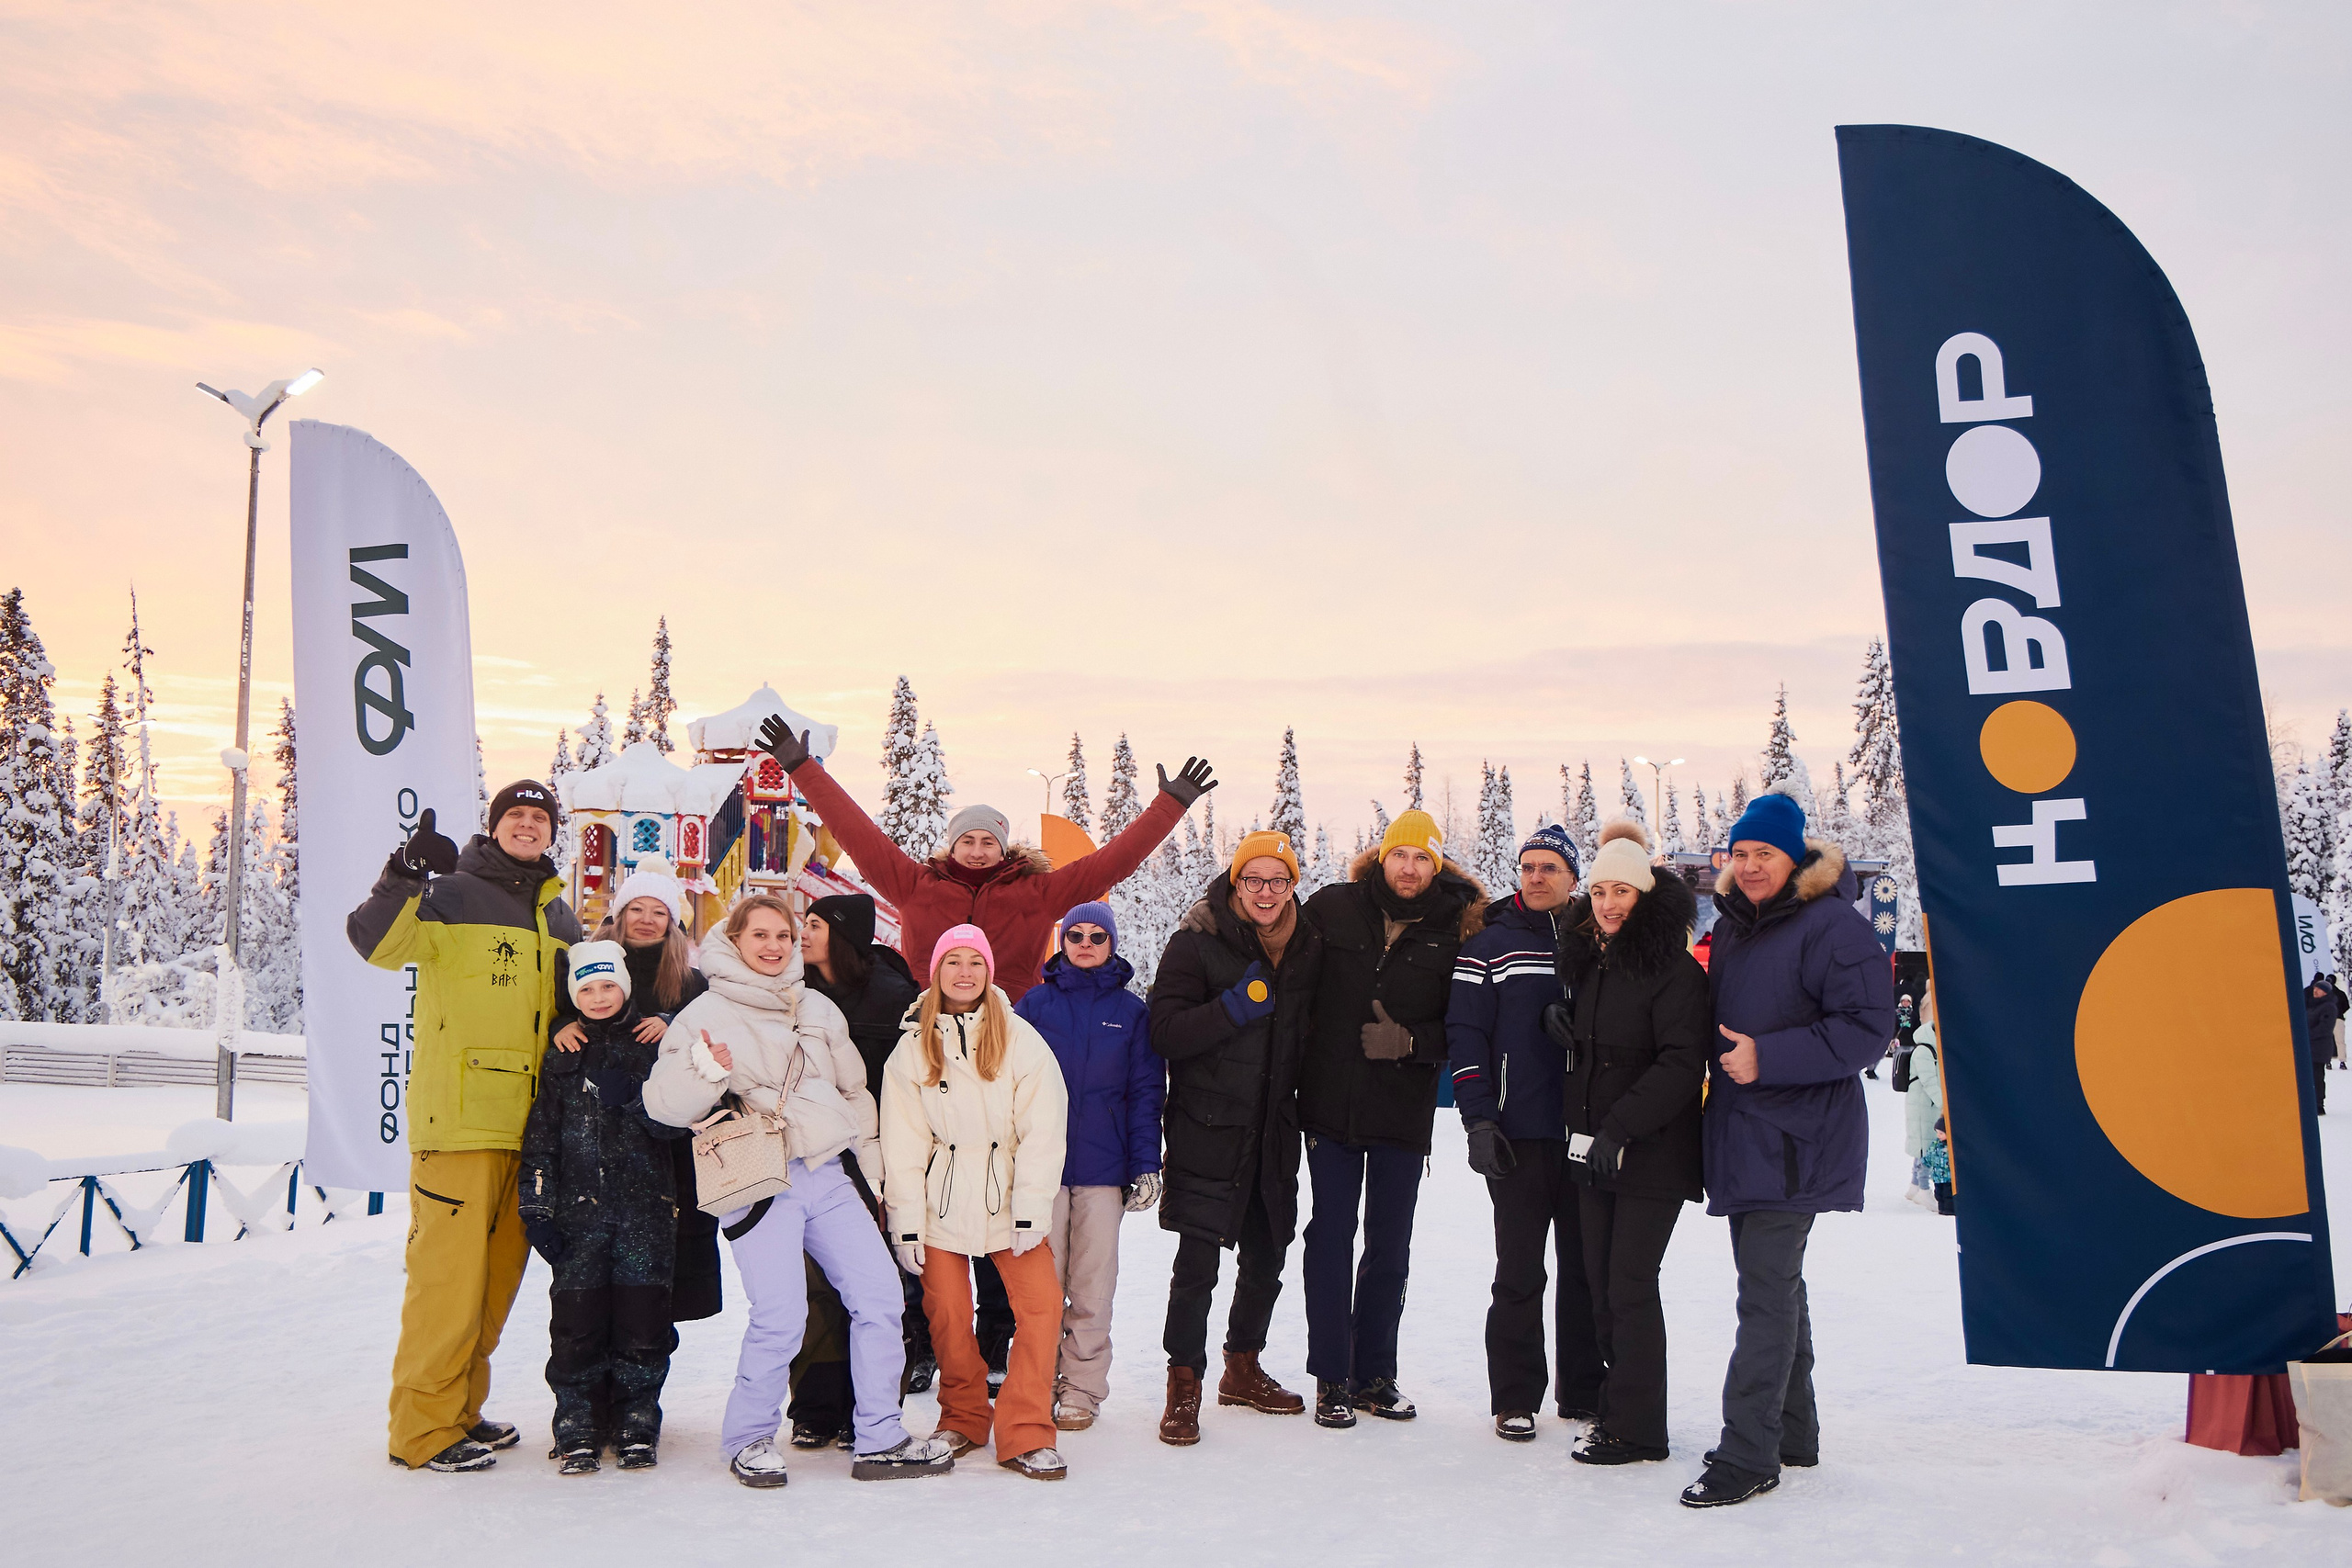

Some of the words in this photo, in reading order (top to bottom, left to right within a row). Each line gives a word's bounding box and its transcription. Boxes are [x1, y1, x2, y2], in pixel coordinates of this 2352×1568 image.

[1935, 332, 2098, 887] НОВДОР
[516, 790, 544, 800] FILA
[380, 1023, 400, 1144] ФОНД
